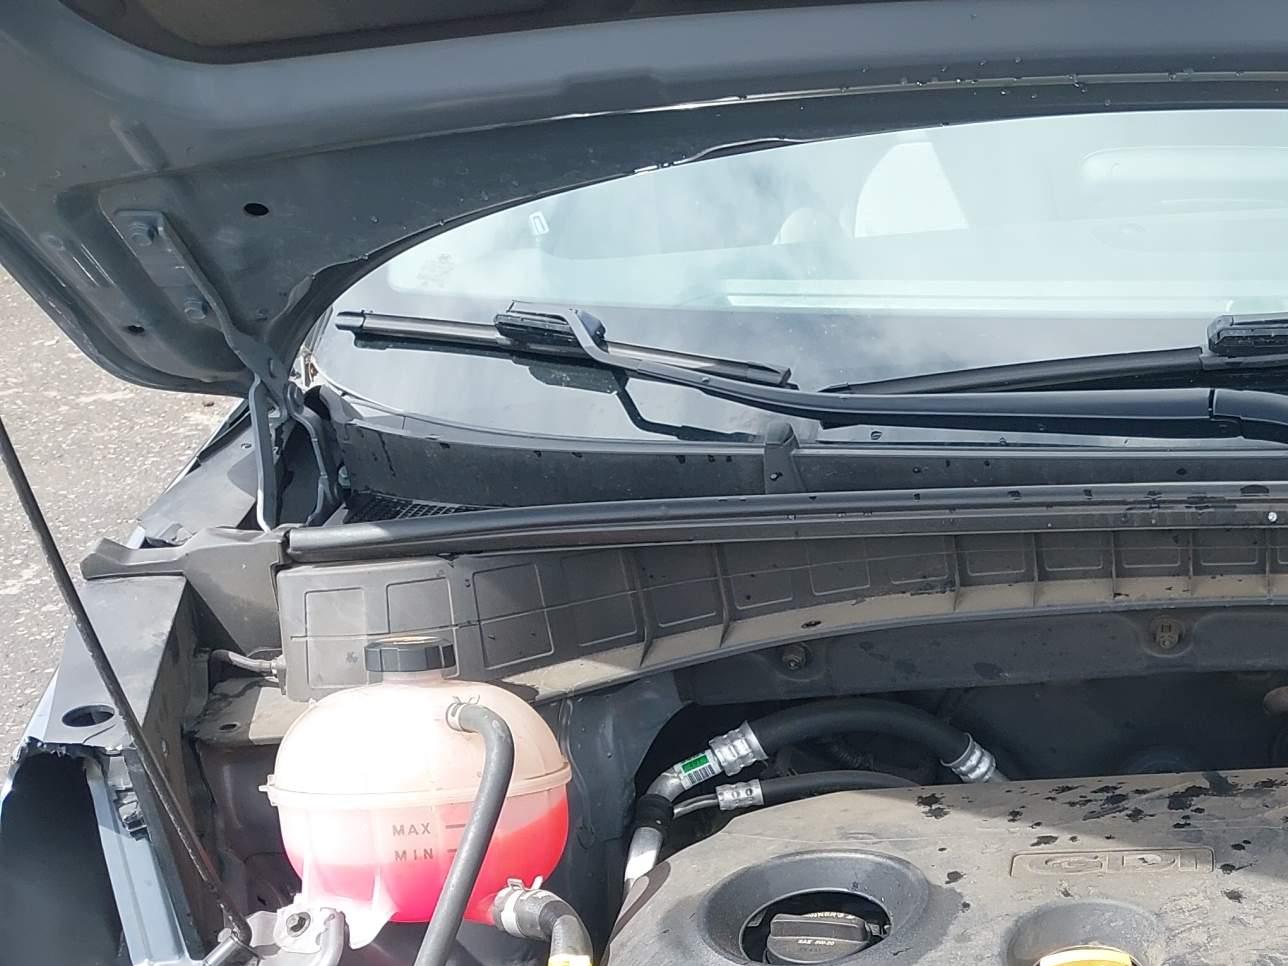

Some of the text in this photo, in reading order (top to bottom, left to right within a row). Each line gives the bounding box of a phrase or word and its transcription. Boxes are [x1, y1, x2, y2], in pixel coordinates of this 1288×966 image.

[392, 822, 431, 836] MAX
[394, 848, 433, 861] MIN
[1027, 853, 1198, 875] GDI
